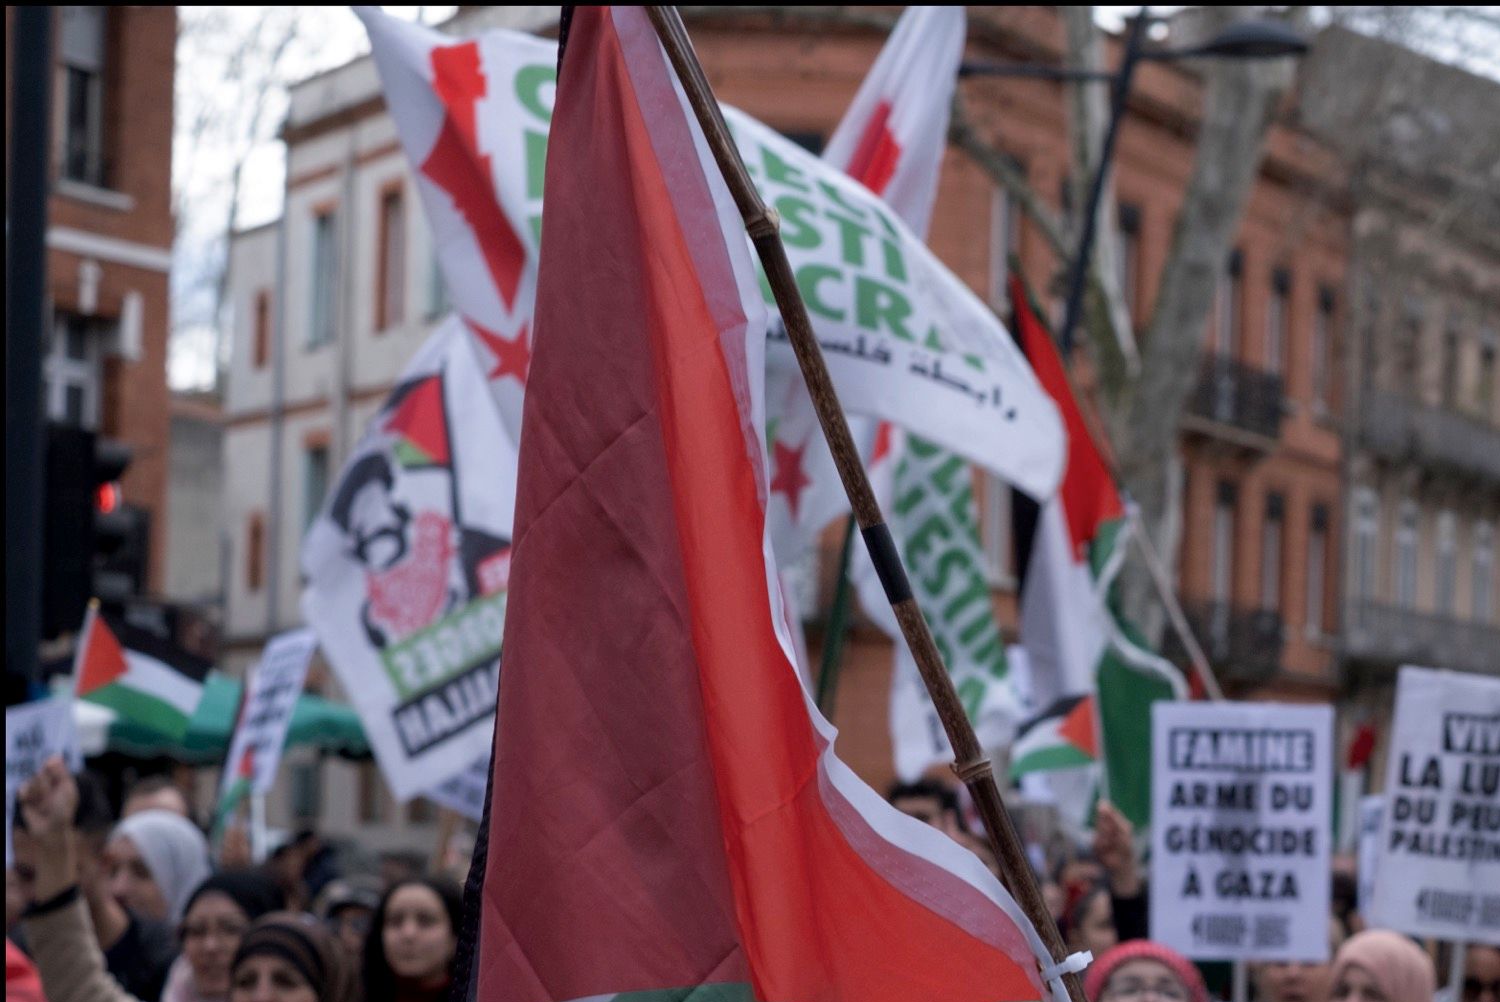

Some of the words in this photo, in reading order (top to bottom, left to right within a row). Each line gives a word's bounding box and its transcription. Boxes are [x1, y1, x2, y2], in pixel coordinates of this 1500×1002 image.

[1172, 730, 1314, 770] FAMINE
[1400, 752, 1441, 789] LA
[1169, 782, 1256, 811] ARME
[1271, 784, 1314, 812] DU
[1393, 795, 1437, 825] DU
[1165, 818, 1316, 857] GÉNOCIDE
[1214, 871, 1298, 899] GAZA
